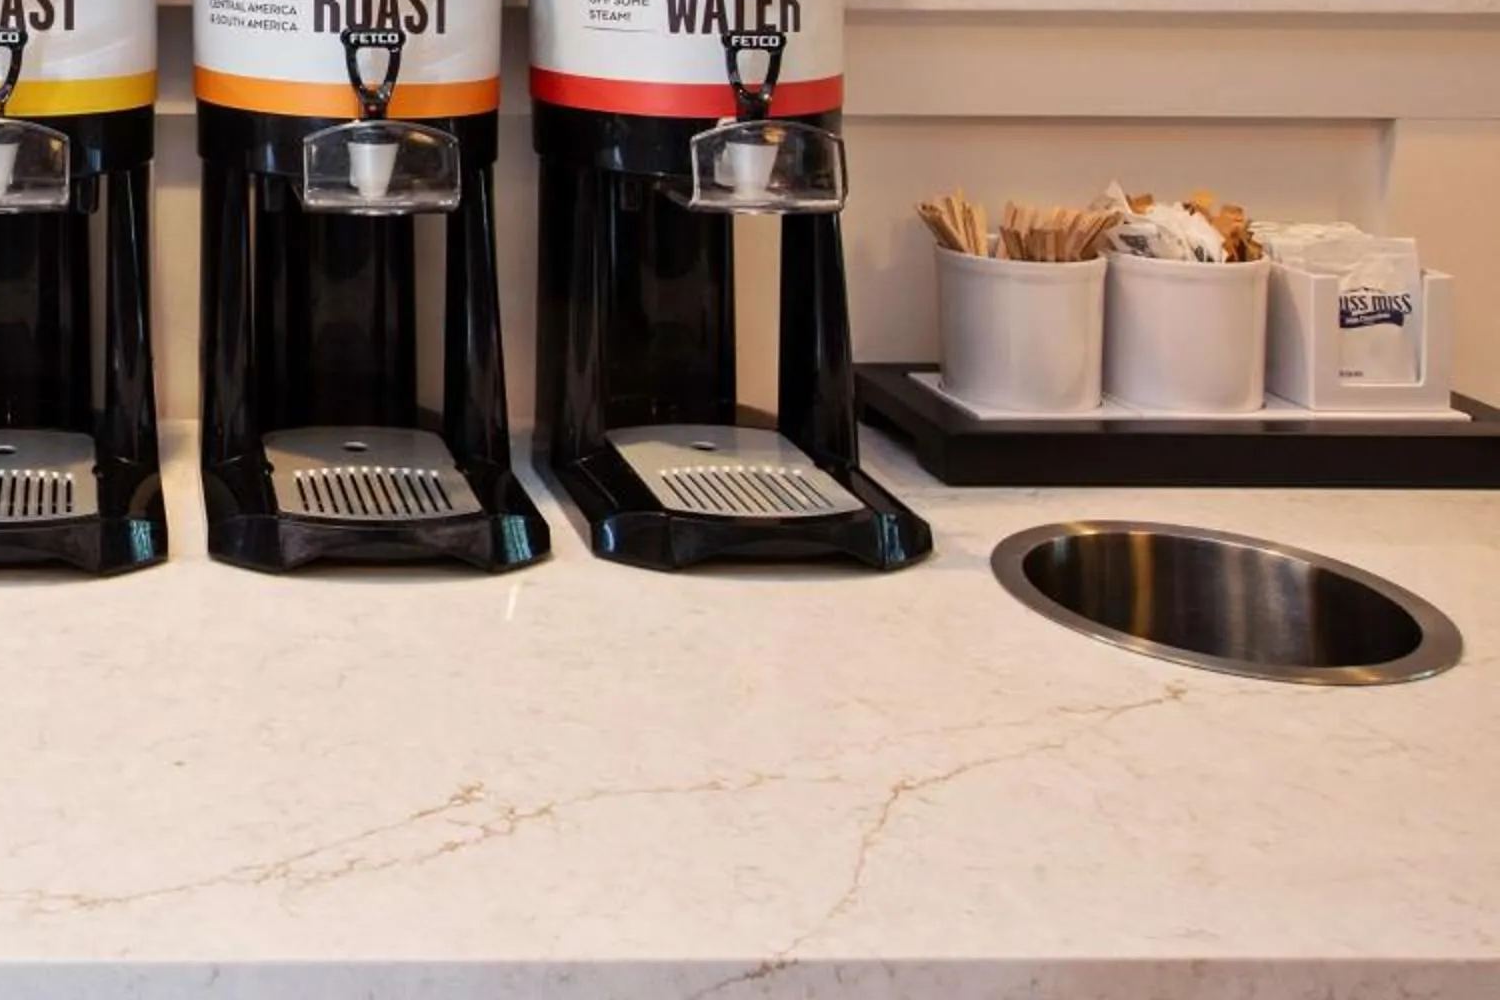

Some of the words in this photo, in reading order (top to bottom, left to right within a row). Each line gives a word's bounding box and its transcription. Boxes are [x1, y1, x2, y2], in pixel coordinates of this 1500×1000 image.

[248, 3, 297, 15] AMERICA
[247, 18, 299, 31] AMERICA
[350, 32, 399, 44] FETCO
[731, 35, 780, 47] FETCO
